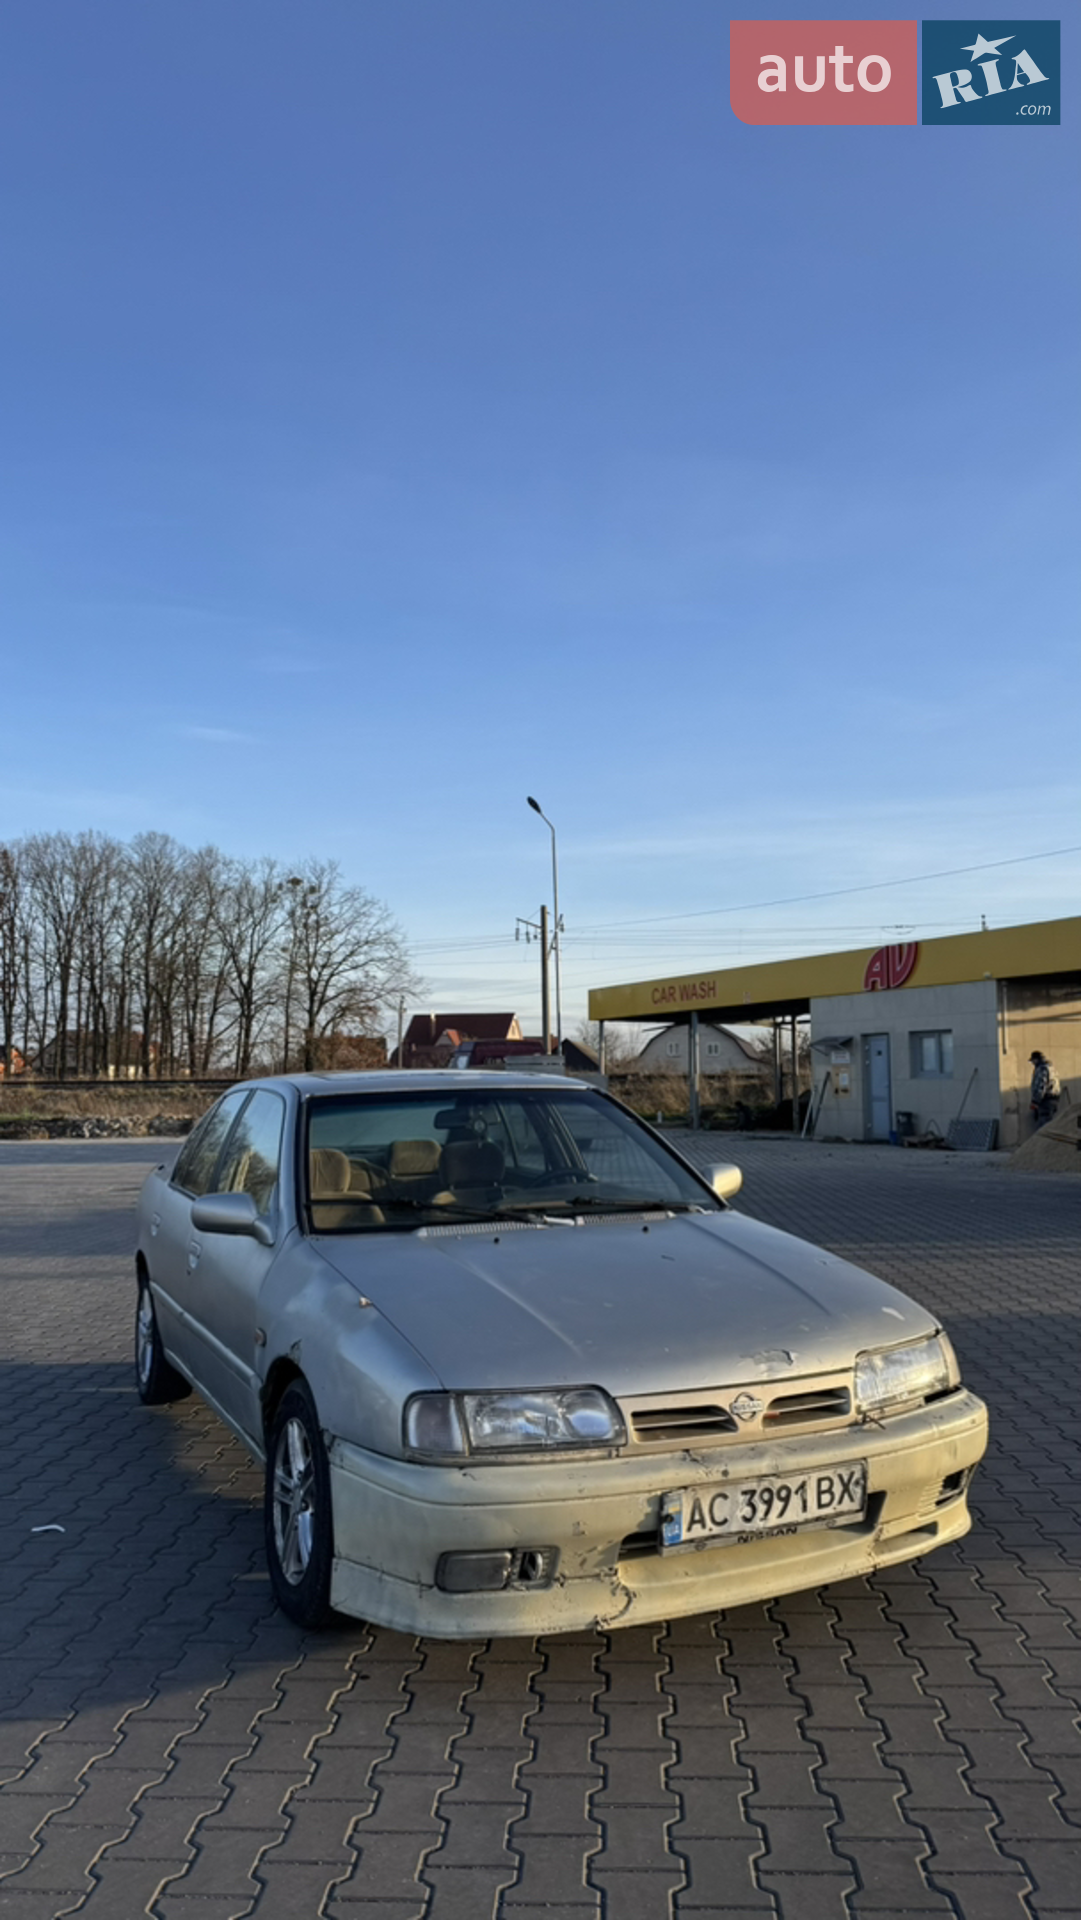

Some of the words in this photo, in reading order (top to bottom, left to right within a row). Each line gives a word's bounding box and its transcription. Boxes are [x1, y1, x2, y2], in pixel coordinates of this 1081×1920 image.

[651, 984, 677, 1005] CAR
[678, 980, 717, 1002] WASH
[686, 1493, 729, 1532] AC
[740, 1480, 808, 1523] 3991
[816, 1471, 856, 1510] BX
